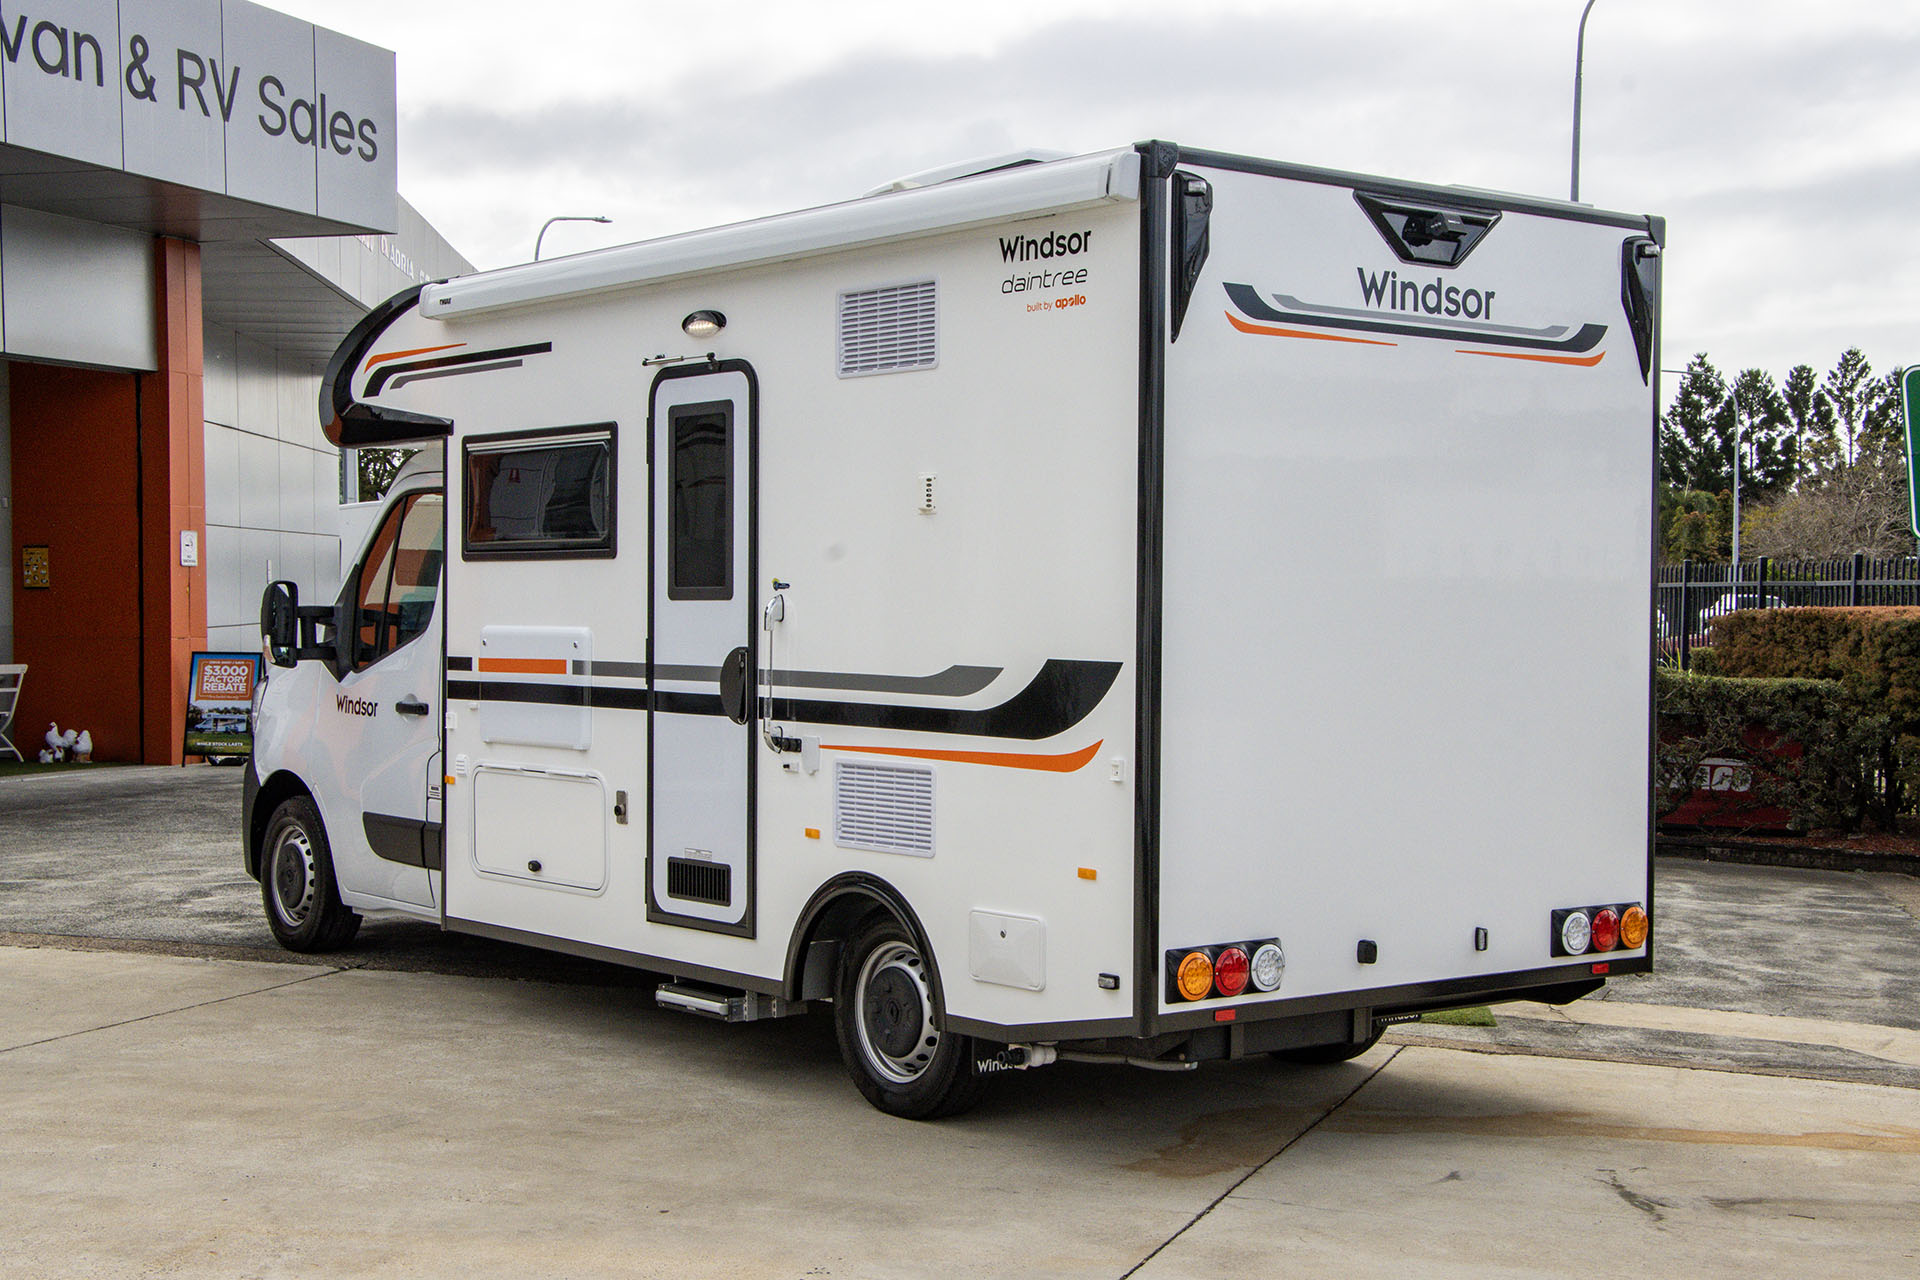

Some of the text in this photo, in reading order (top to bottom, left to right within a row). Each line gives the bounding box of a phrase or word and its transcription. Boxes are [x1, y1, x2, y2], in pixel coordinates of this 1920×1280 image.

[125, 34, 157, 102] &
[177, 48, 240, 122] RV
[258, 75, 377, 162] Sales
[999, 231, 1091, 263] Windsor
[390, 243, 414, 280] ADRIA
[1002, 268, 1088, 293] daintree
[1357, 267, 1496, 320] Windsor
[1027, 294, 1086, 312] built by apollo
[203, 683, 247, 691] REBATE
[336, 694, 378, 717] Windsor
